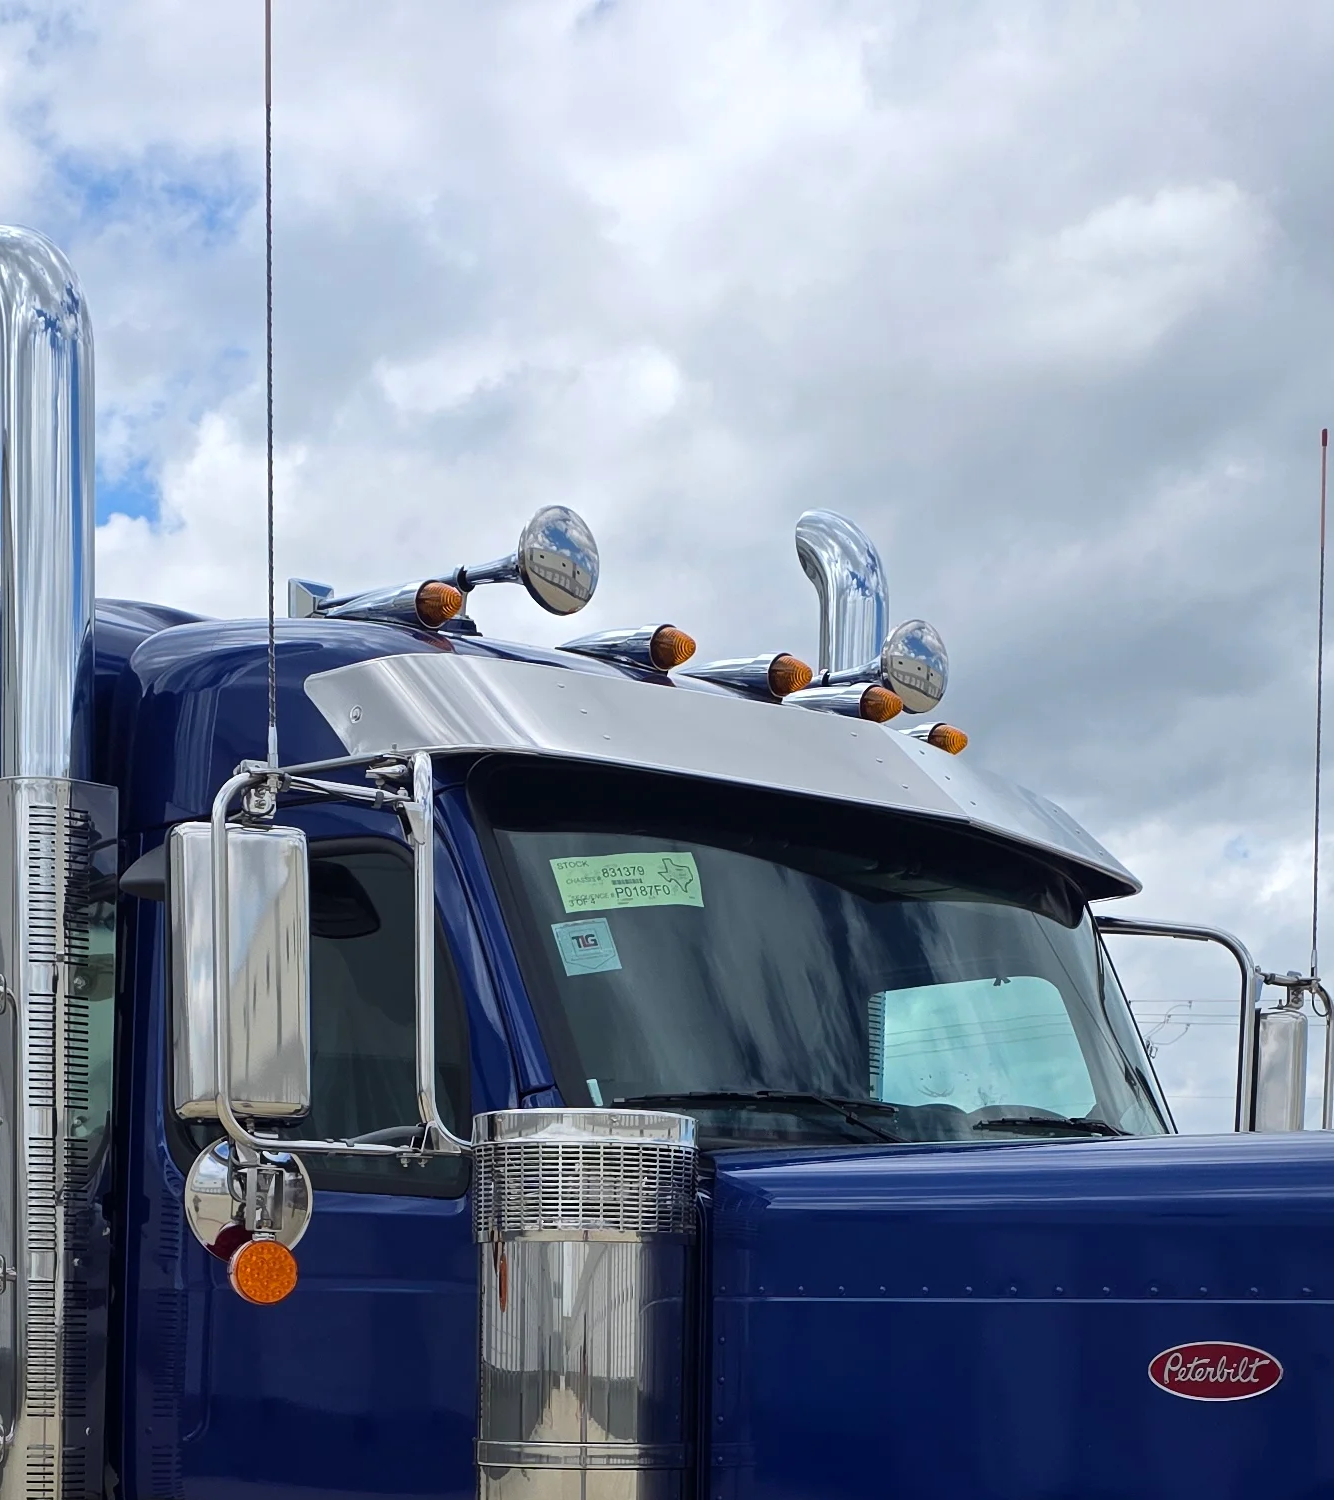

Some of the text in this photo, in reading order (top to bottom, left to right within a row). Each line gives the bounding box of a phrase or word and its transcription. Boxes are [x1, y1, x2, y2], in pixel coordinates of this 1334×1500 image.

[557, 861, 589, 870] STOCK
[602, 866, 645, 878] 831379
[614, 884, 671, 898] P0187F0
[576, 898, 588, 906] OF
[572, 934, 598, 948] TLG
[1163, 1352, 1271, 1384] Peterbilt
